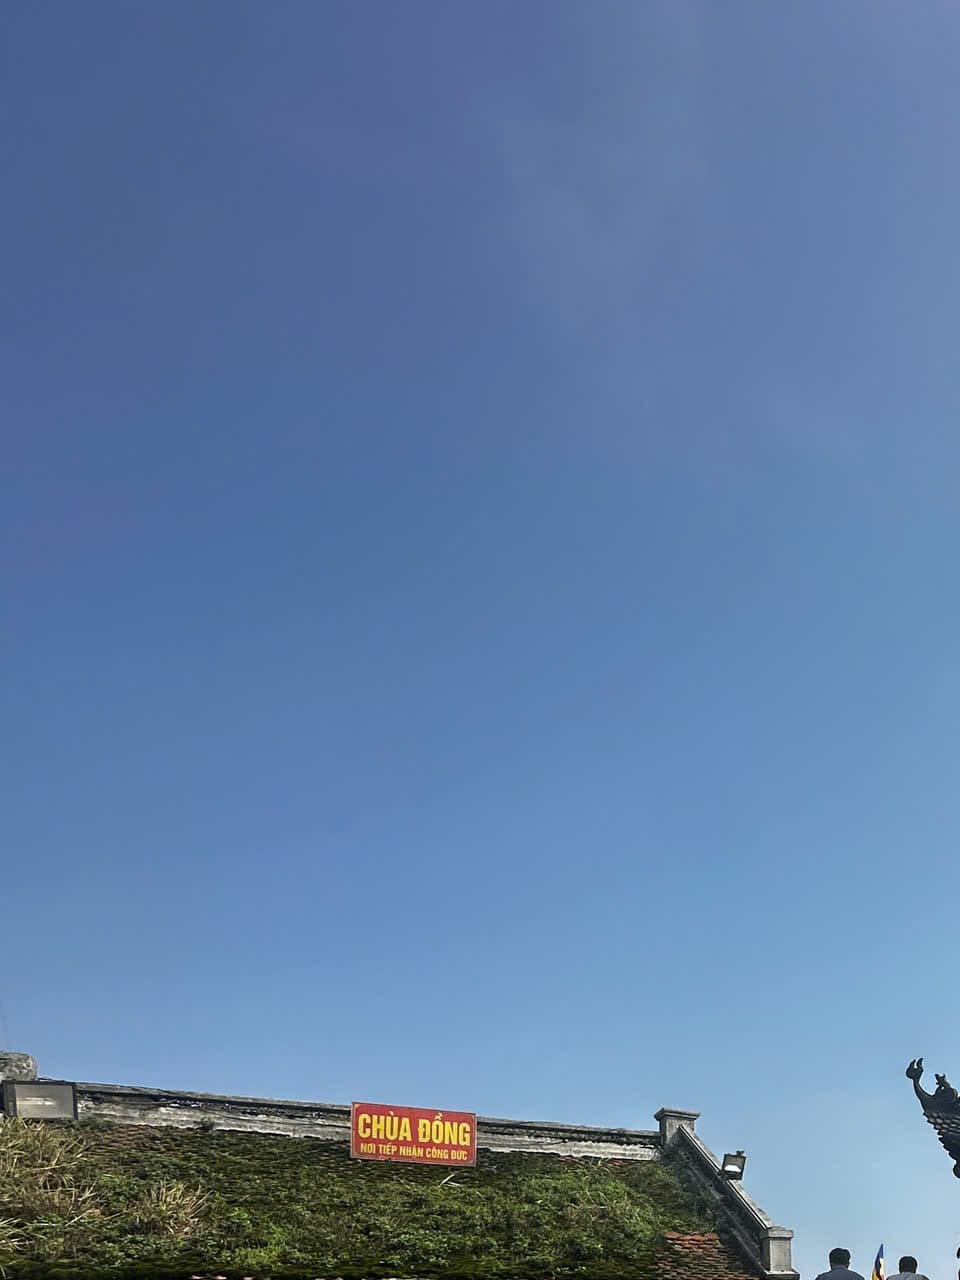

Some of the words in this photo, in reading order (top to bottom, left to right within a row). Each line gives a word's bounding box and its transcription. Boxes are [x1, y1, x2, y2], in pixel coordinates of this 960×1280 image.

[358, 1110, 412, 1142] CHÙA
[418, 1112, 471, 1146] ĐỒNG
[360, 1142, 376, 1154] NƠI
[378, 1142, 398, 1155] TIẾP
[400, 1145, 424, 1160] NHẬN
[425, 1146, 449, 1160] CÔNG
